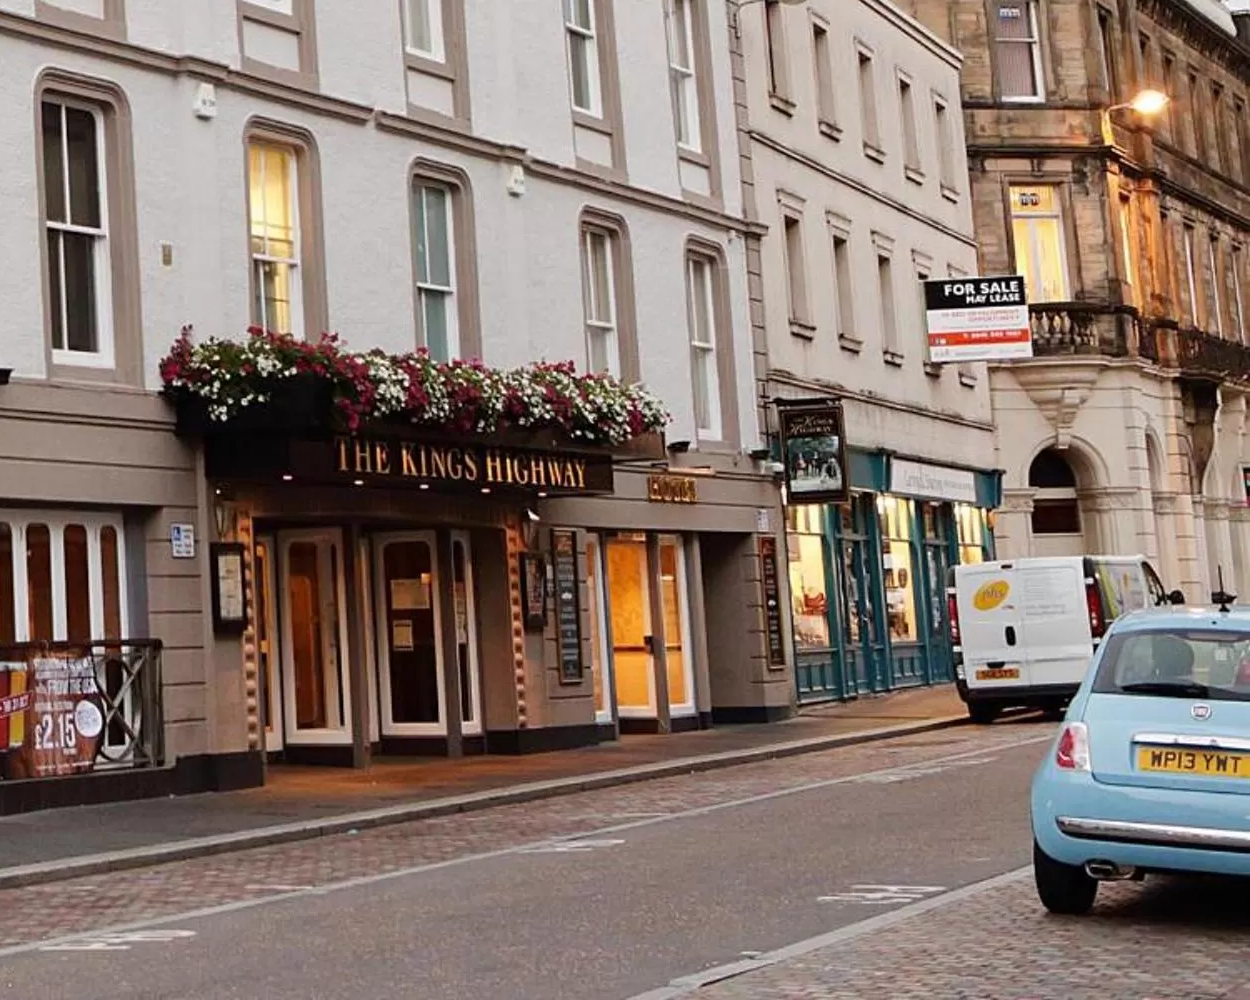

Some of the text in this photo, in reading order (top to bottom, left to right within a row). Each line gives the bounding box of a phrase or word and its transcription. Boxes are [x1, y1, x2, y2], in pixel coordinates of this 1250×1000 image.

[944, 281, 1020, 296] FOR SALE
[966, 293, 1021, 304] MAY LEASE
[335, 437, 587, 488] THE KINGS HIGHWAY
[35, 713, 76, 750] £2.15
[1151, 750, 1242, 774] WP13 YWT
